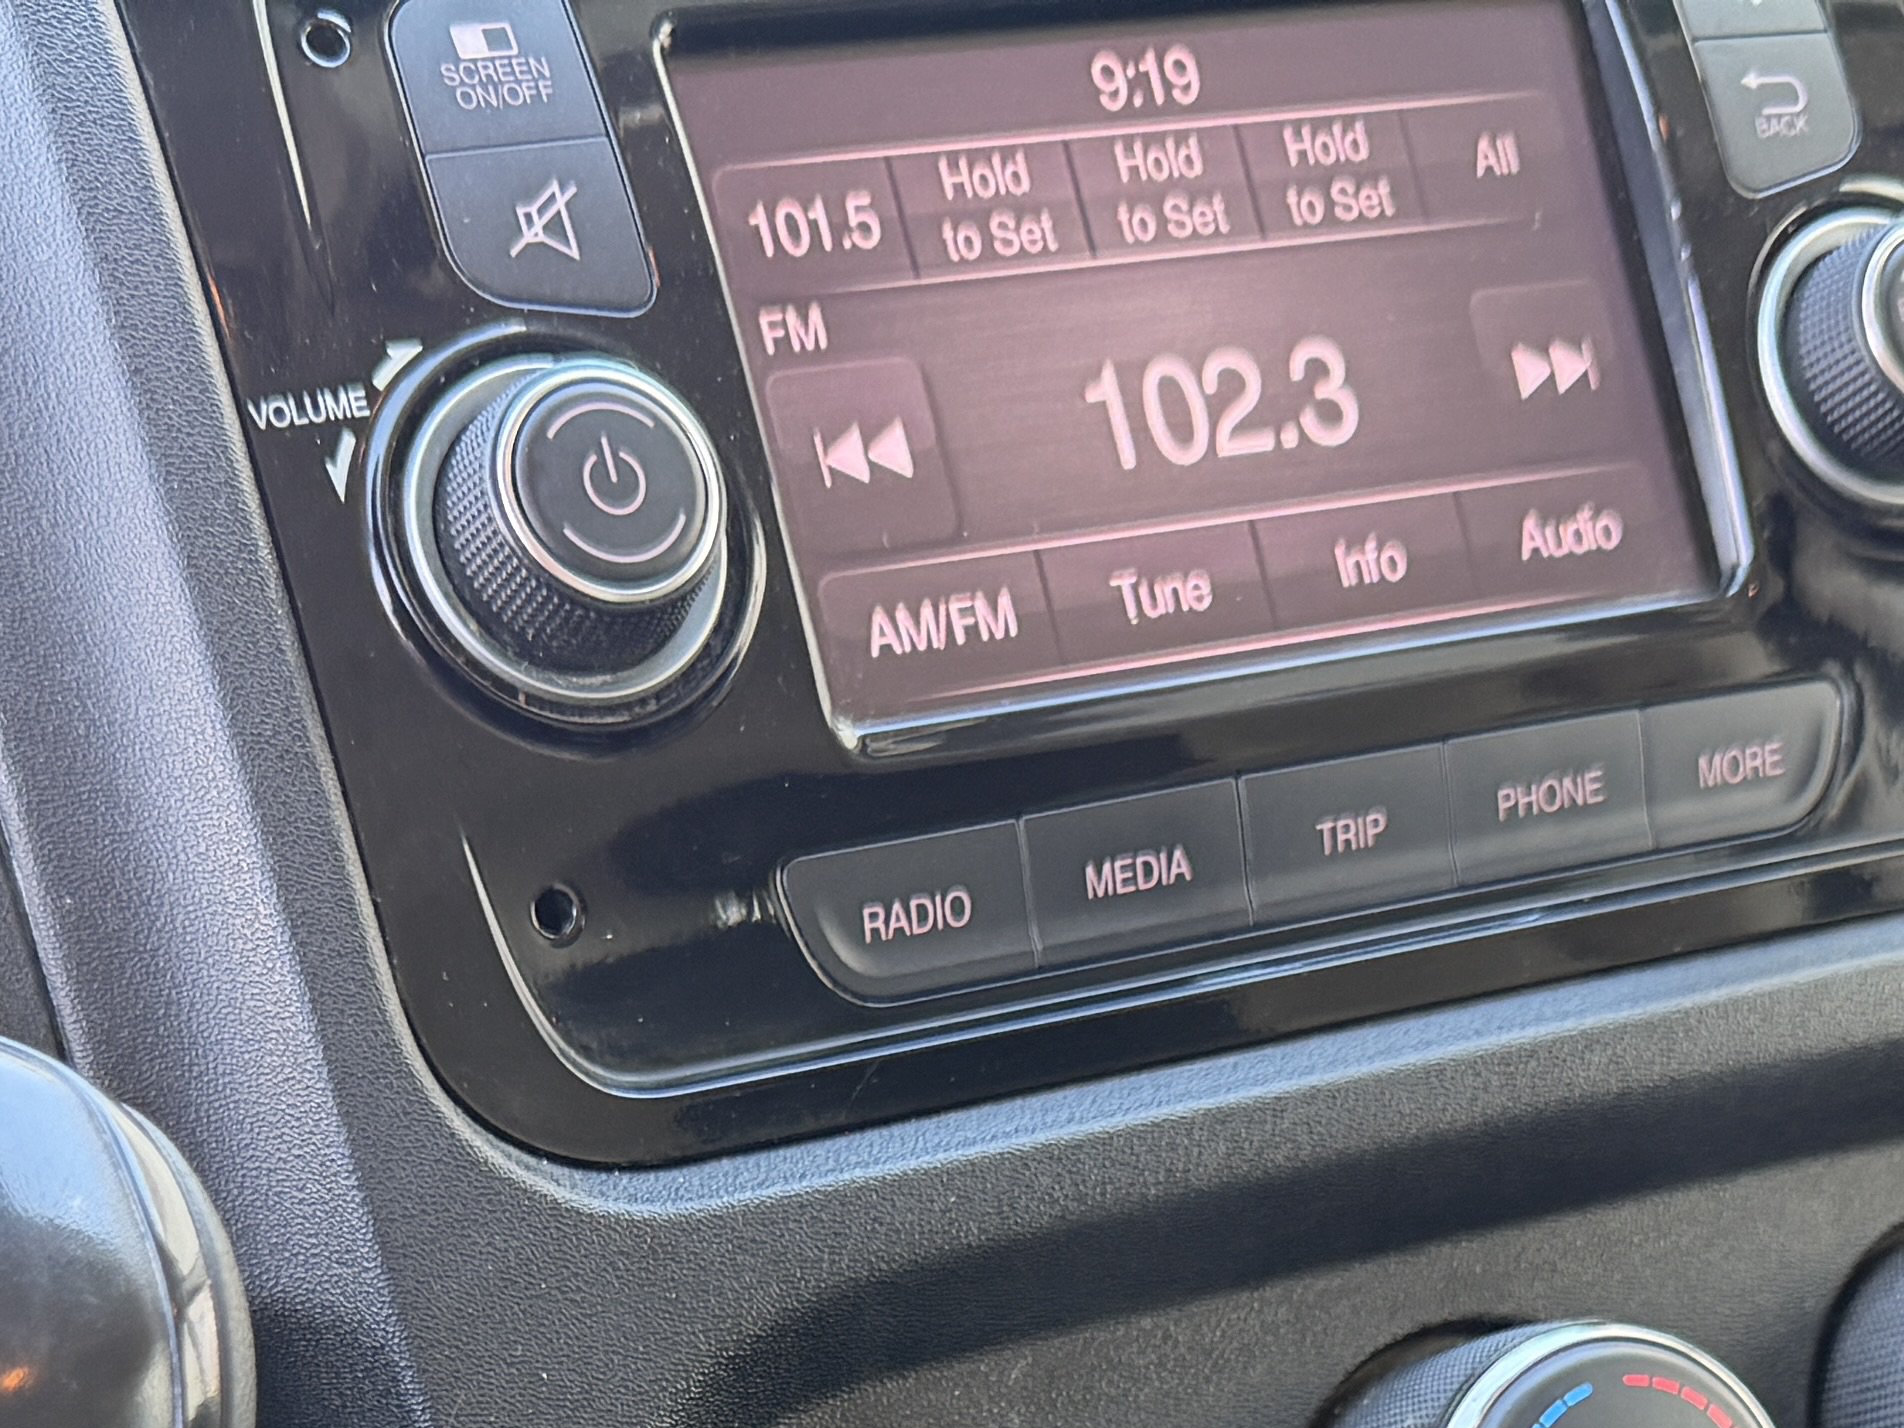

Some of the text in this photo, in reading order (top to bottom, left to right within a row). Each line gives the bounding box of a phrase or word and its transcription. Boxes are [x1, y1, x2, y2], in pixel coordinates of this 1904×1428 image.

[441, 57, 551, 86] SCREEN
[455, 81, 553, 110] ON/OFF
[1091, 44, 1200, 112] 9:19
[1284, 121, 1370, 169] Hold
[1755, 113, 1809, 138] BACK
[936, 150, 1032, 199] Hold
[1114, 137, 1203, 185] Hold
[1474, 133, 1520, 180] All
[748, 191, 884, 259] 101.5
[1117, 192, 1231, 243] to Set
[1286, 176, 1396, 224] to Set
[942, 208, 1060, 262] to Set
[758, 303, 829, 356] FM
[247, 388, 370, 431] VOLUME
[1084, 335, 1360, 473] 102.3
[1520, 504, 1623, 562] Audio
[1332, 537, 1409, 589] Info
[1108, 566, 1213, 626] Tune
[870, 589, 1018, 656] AM/FM
[1697, 740, 1786, 789] MORE
[1495, 768, 1606, 822] PHONE
[1315, 808, 1389, 856] TRIP
[1083, 845, 1193, 900] MEDIA
[861, 890, 973, 943] RADIO
